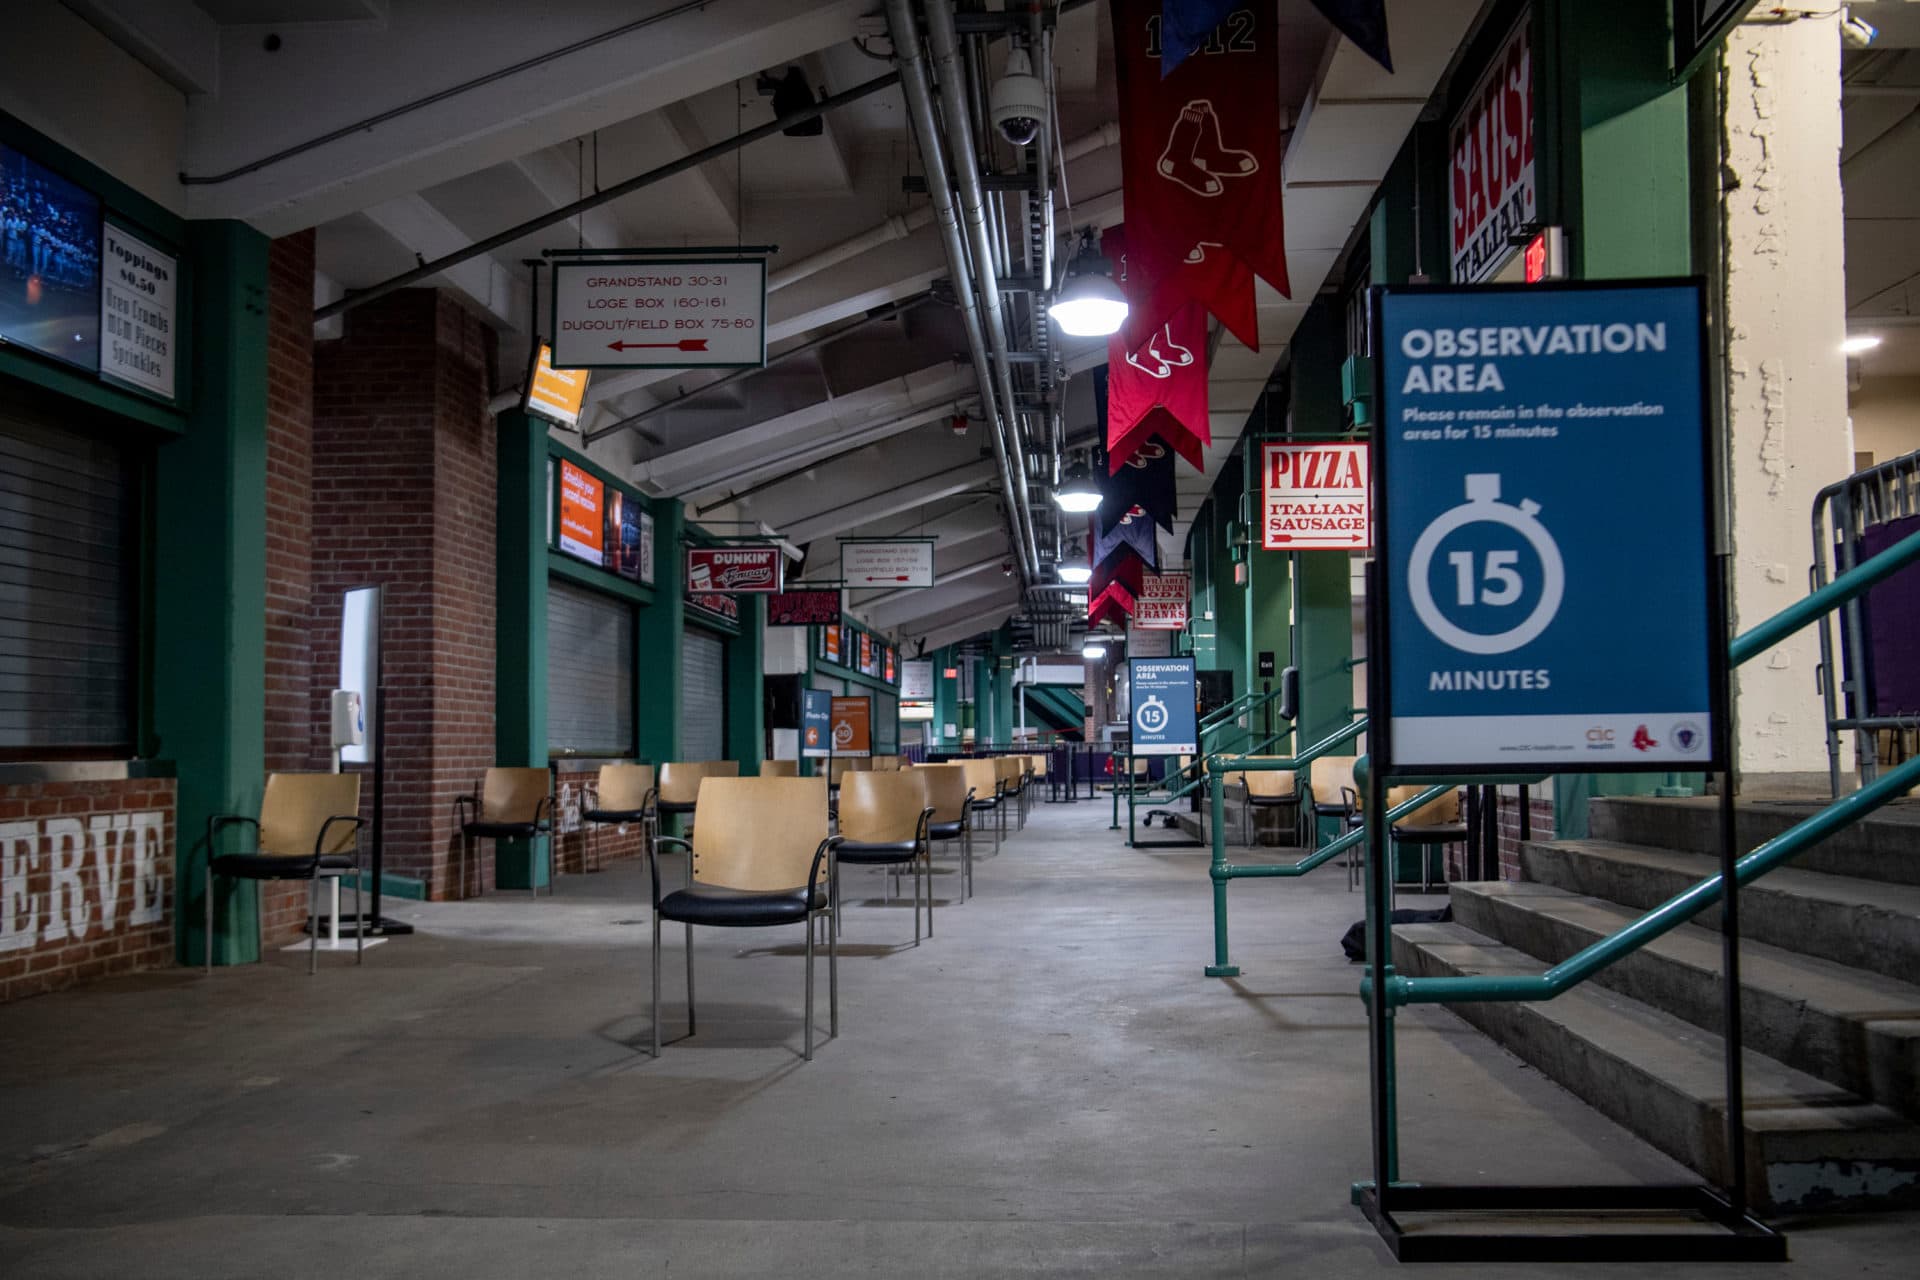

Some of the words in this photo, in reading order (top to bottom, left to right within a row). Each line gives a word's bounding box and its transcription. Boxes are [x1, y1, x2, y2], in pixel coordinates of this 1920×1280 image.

[107, 238, 168, 281] Toppings
[586, 276, 682, 288] GRANDSTAND
[687, 276, 728, 287] 30-31
[587, 298, 628, 309] LOGE
[635, 298, 665, 308] BOX
[672, 297, 727, 308] 160-161
[132, 300, 169, 333] Crumbs
[561, 318, 669, 331] DUGOUT/FIELD
[674, 318, 704, 329] BOX
[711, 318, 755, 329] 75-80
[1401, 323, 1666, 359] OBSERVATION
[112, 339, 161, 378] Sprinkles
[1402, 363, 1505, 394] AREA
[1402, 408, 1455, 422] Please
[1458, 406, 1516, 420] remain
[1518, 405, 1534, 418] in
[1536, 404, 1564, 418] the
[1566, 402, 1664, 418] observation
[1403, 429, 1442, 441] area
[1444, 426, 1469, 440] for
[1473, 426, 1492, 439] 15
[1494, 424, 1558, 438] minutes
[1270, 451, 1363, 489] PIZZA
[1270, 504, 1364, 515] ITALIAN
[1270, 518, 1364, 530] SAUSAGE
[713, 552, 770, 565] DUNKIN'
[719, 566, 773, 586] Fenway
[1449, 550, 1523, 606] 15
[1136, 602, 1183, 610] FENWAY
[1136, 610, 1185, 619] FRANKS
[1136, 664, 1189, 673] OBSERVATION
[1136, 672, 1157, 680] AREA
[1430, 669, 1550, 690] MINUTES
[1144, 709, 1160, 723] 15
